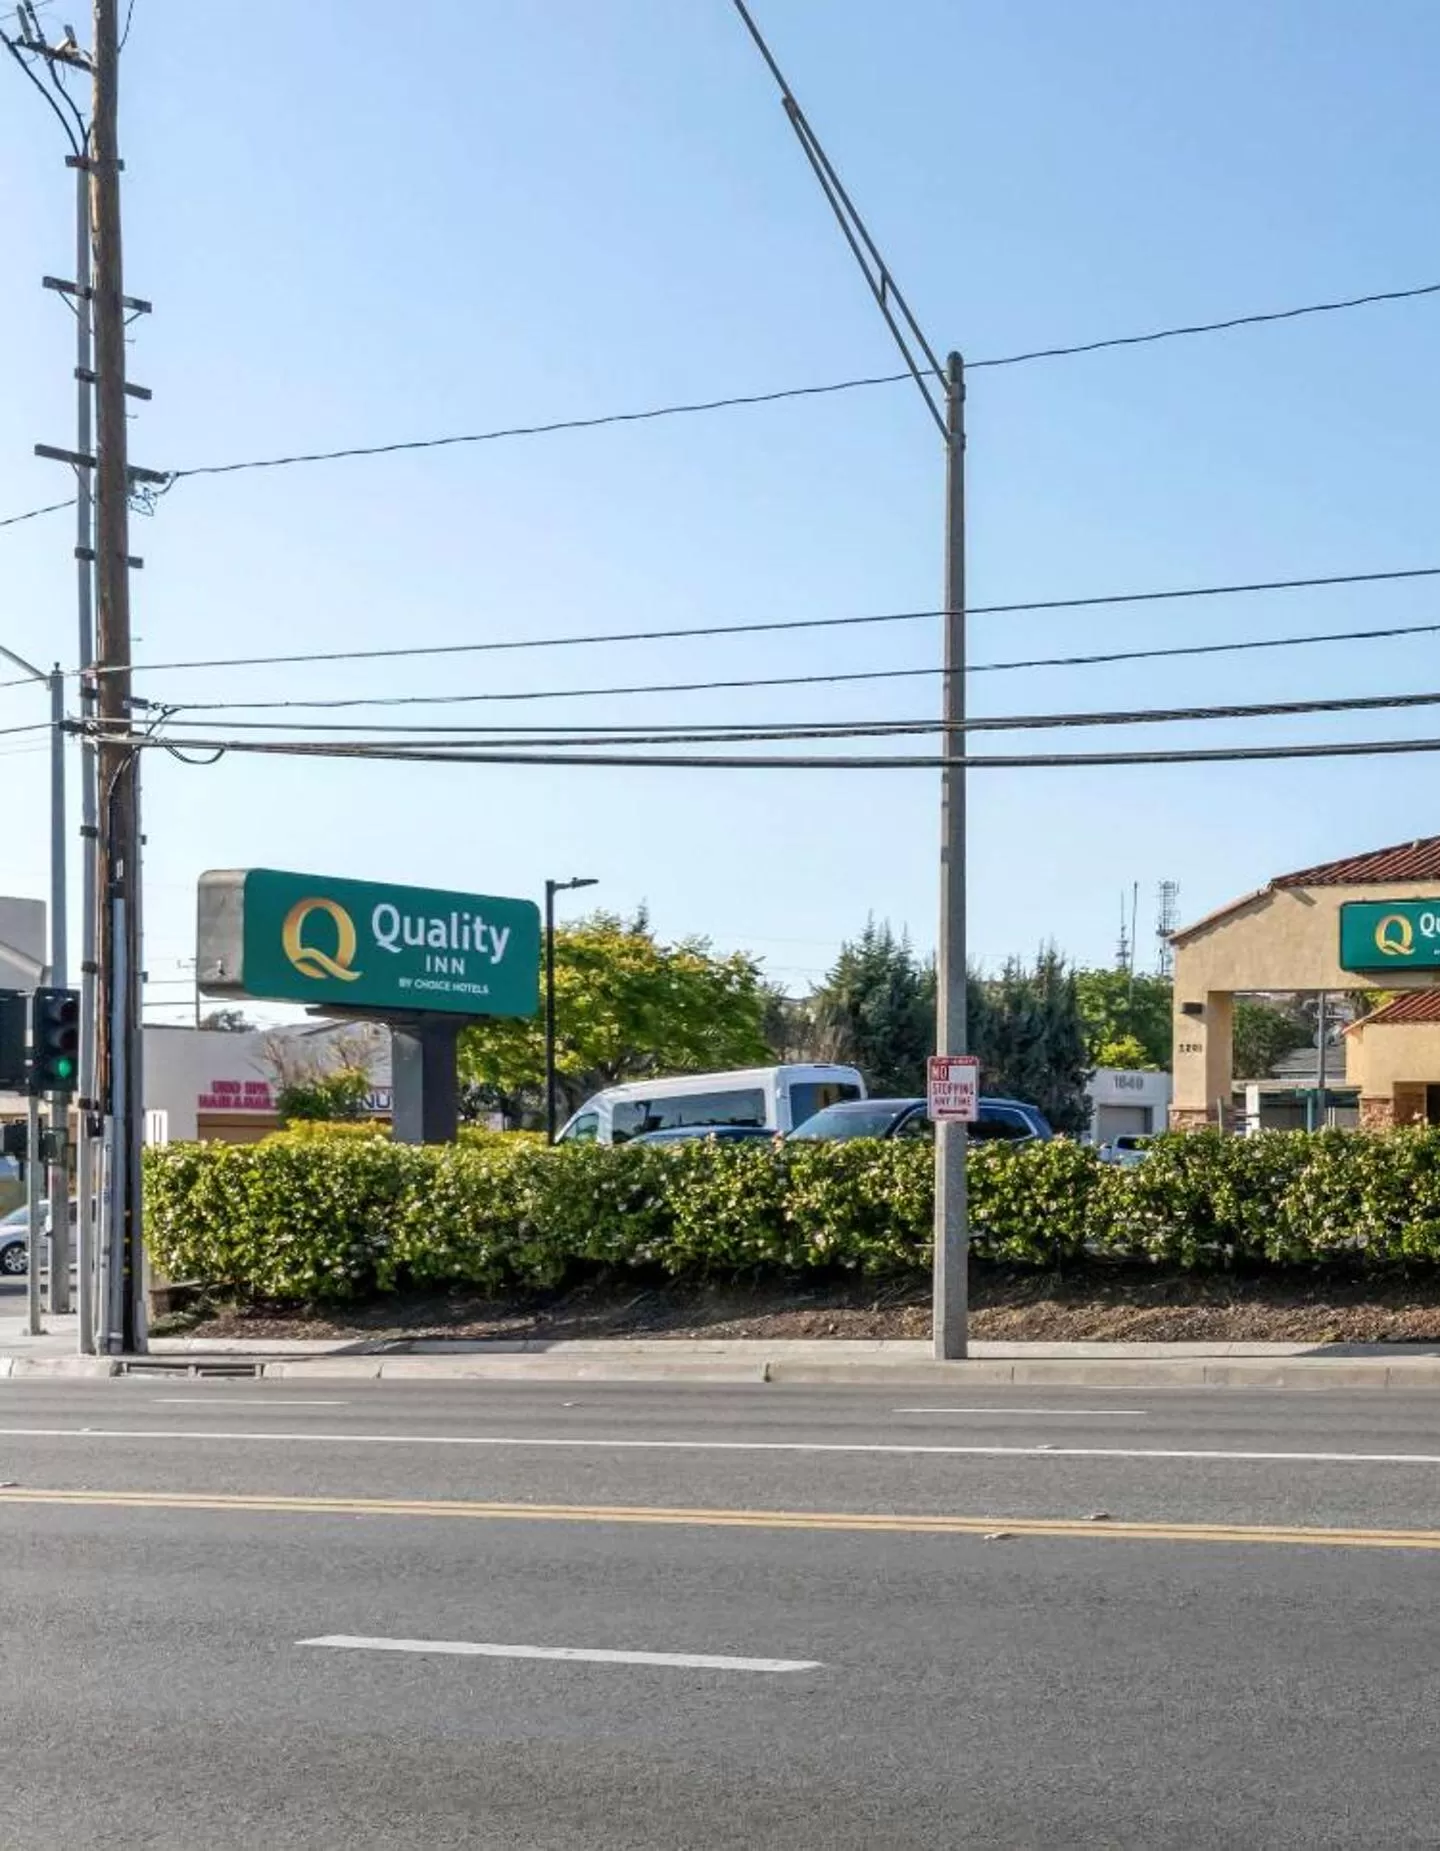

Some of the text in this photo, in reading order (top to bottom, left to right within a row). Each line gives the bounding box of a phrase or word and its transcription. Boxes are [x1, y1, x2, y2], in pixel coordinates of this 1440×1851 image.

[282, 897, 363, 981] Q
[371, 903, 511, 965] Quality
[1374, 914, 1416, 956] Q
[425, 954, 465, 975] INN
[399, 977, 489, 994] BY CHOICE HOTELS
[931, 1065, 948, 1081] NO
[932, 1082, 974, 1096] STOPPING
